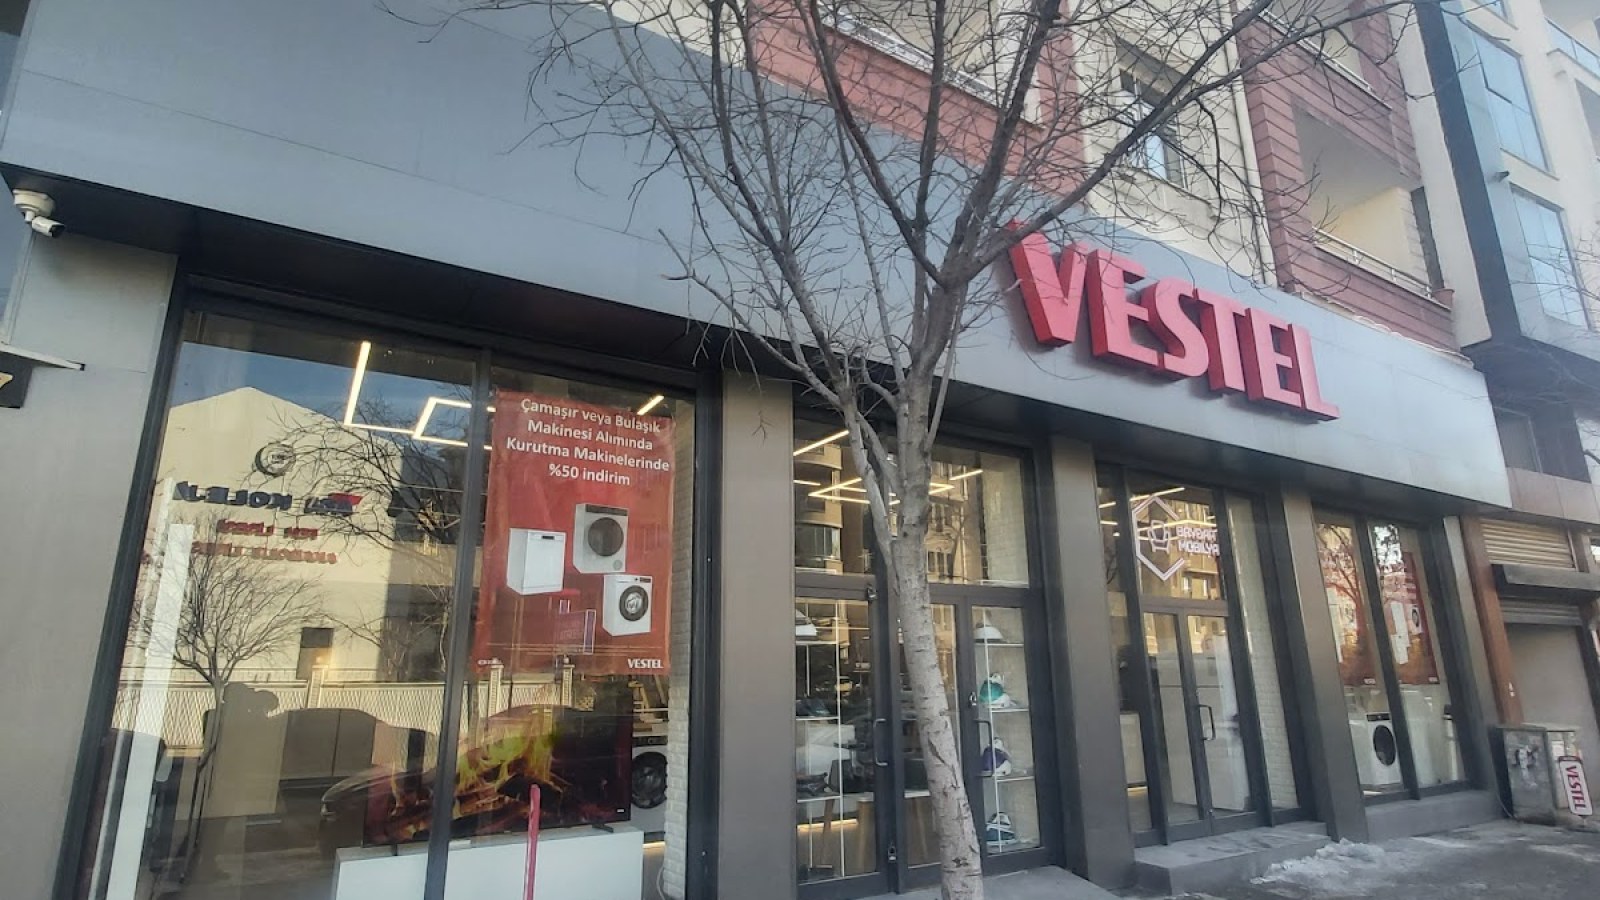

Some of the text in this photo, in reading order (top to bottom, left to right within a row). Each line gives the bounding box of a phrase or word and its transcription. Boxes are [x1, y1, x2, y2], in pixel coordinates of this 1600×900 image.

[1006, 219, 1340, 421] VESTEL
[521, 398, 661, 435] Çamaşır veya Bulaşık
[527, 419, 653, 451] Makinesi Alımında
[506, 437, 670, 472] Kurutma Makinelerinde
[549, 463, 630, 486] %50 indirim
[627, 658, 664, 669] VESTEL
[1566, 766, 1586, 810] VESTEL
